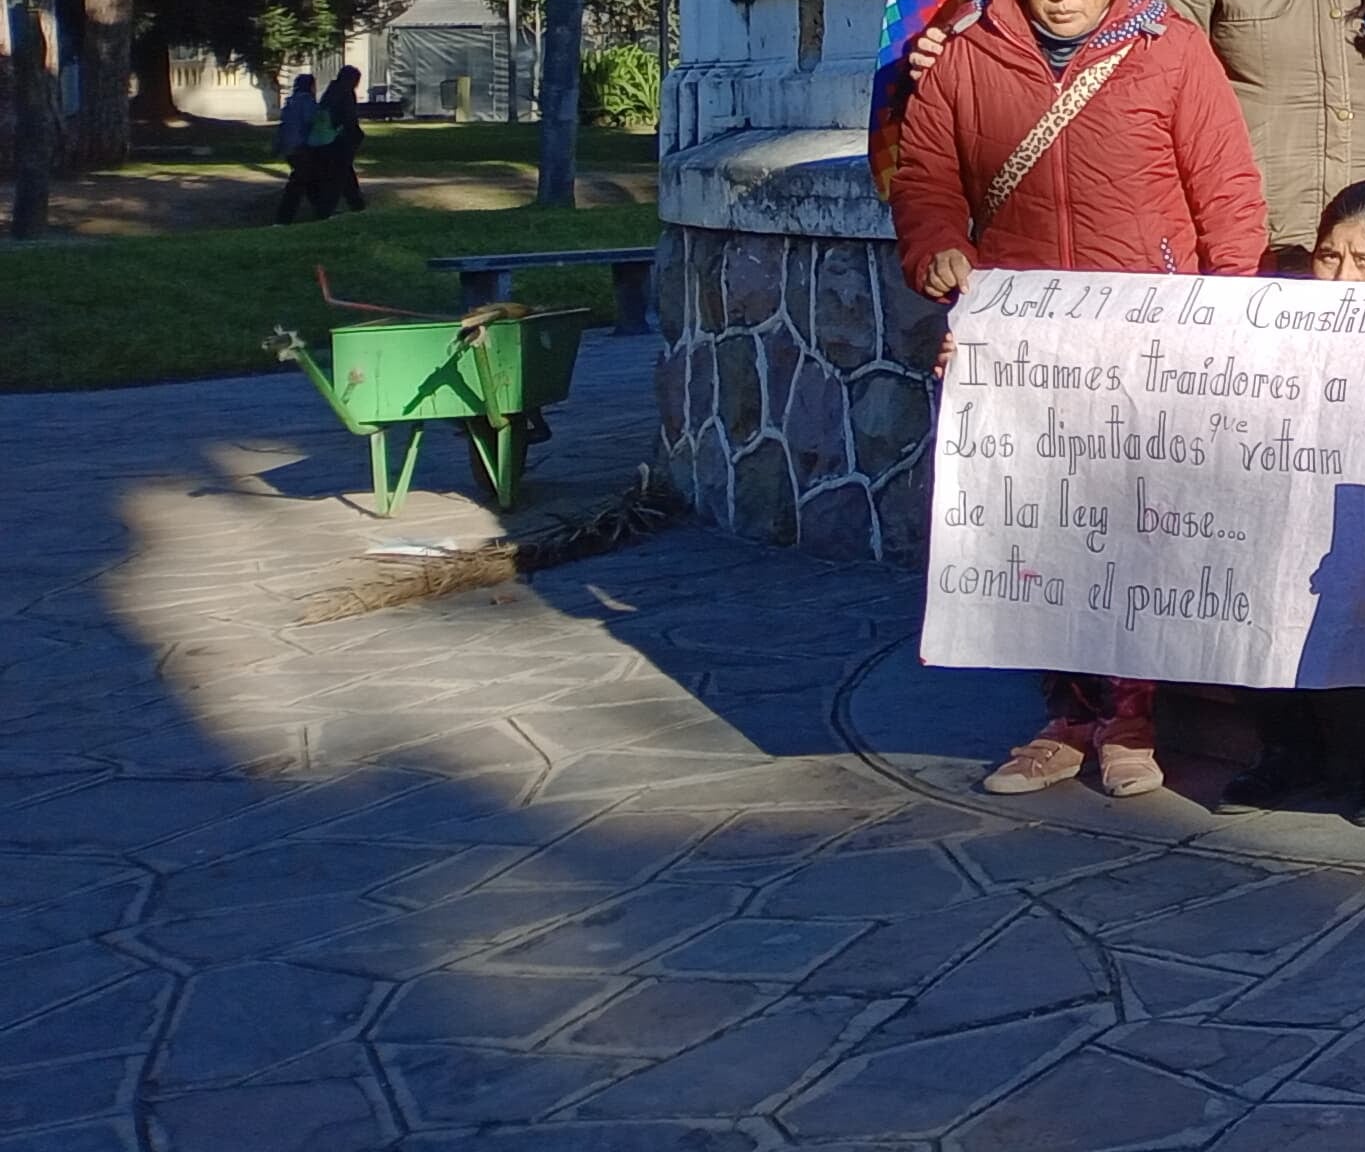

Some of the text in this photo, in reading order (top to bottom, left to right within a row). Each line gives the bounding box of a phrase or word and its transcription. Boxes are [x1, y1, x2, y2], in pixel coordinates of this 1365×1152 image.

[1125, 286, 1164, 325] de
[1177, 277, 1215, 326] la
[958, 339, 1121, 391] Infames
[1141, 339, 1301, 401] traidores
[1323, 376, 1347, 403] a
[943, 401, 1014, 459] Los
[1036, 404, 1206, 476] diputados
[1209, 412, 1249, 443] que
[1239, 418, 1343, 475] votan
[944, 490, 985, 527] de
[1004, 475, 1039, 529] la
[1059, 478, 1108, 554] ley
[939, 544, 1064, 607] contra
[1088, 561, 1116, 611] el
